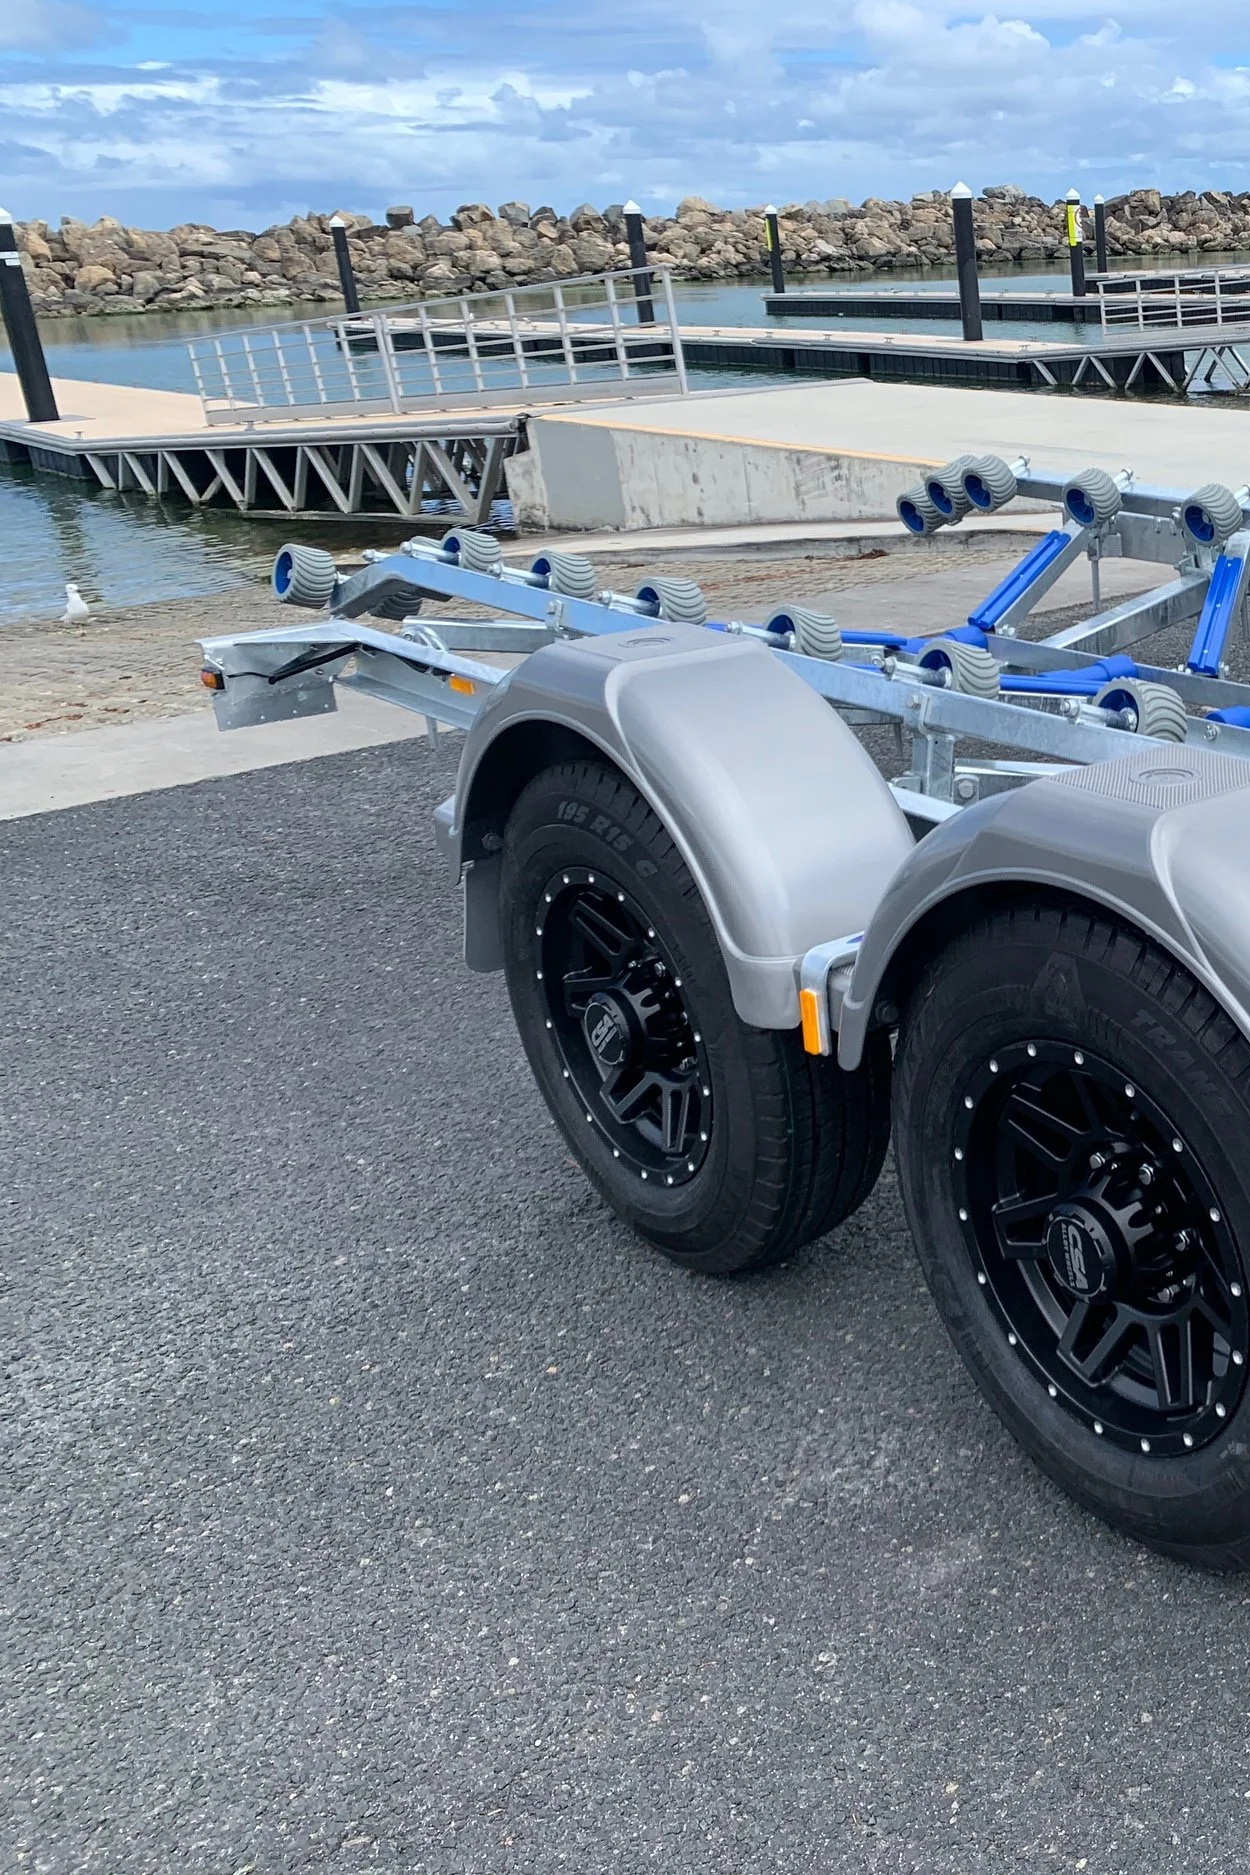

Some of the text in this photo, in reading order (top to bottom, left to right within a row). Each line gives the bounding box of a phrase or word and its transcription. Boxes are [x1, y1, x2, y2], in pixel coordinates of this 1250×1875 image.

[557, 800, 590, 824] 195
[590, 815, 634, 852] R15
[1067, 1224, 1089, 1290] CSA
